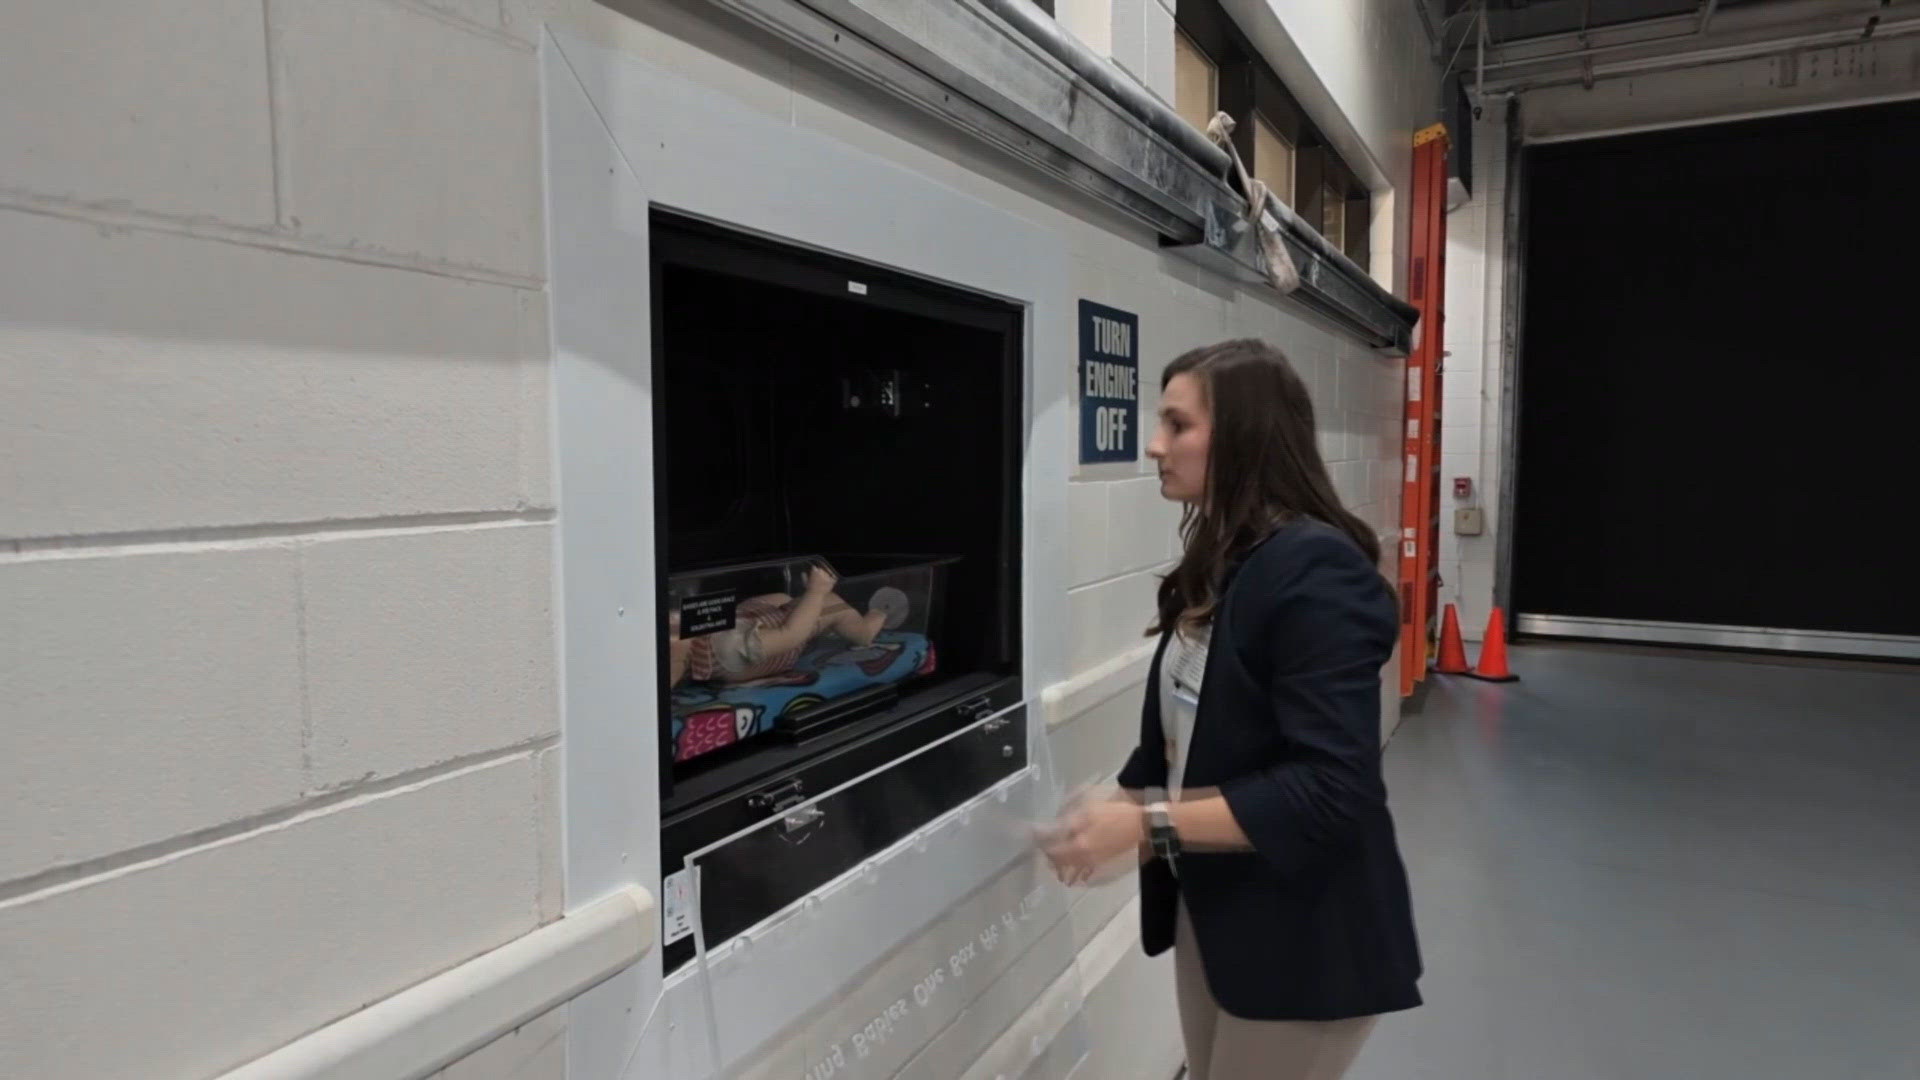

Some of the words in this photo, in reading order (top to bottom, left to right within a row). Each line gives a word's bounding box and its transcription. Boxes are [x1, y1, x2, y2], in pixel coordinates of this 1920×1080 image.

[1092, 316, 1131, 358] TURN
[1086, 359, 1137, 400] ENGINE
[1096, 406, 1127, 452] OFF
